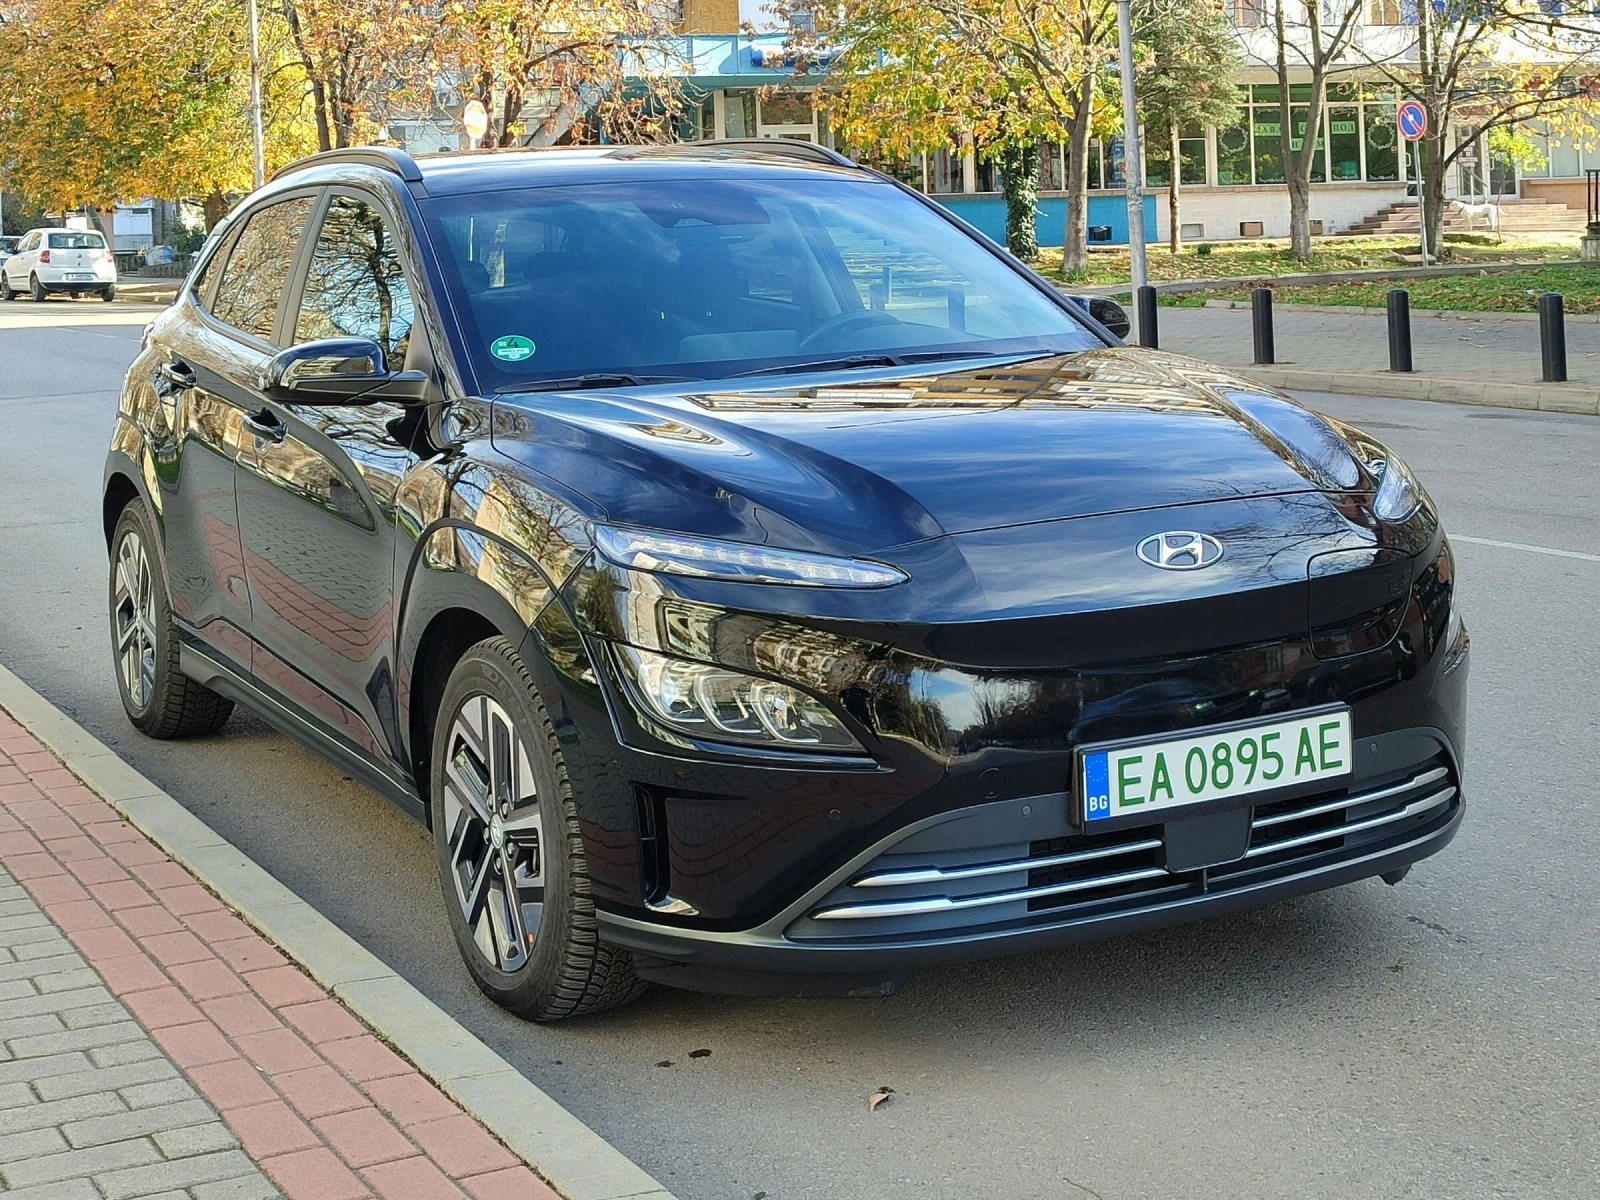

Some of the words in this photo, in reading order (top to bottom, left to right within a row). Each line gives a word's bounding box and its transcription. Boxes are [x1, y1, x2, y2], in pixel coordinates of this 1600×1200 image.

[1333, 123, 1354, 132] ПОД
[507, 337, 519, 348] 4
[1117, 752, 1174, 807] EA
[1185, 732, 1284, 794] 0895
[1295, 721, 1343, 776] AE
[1089, 794, 1108, 811] BG
